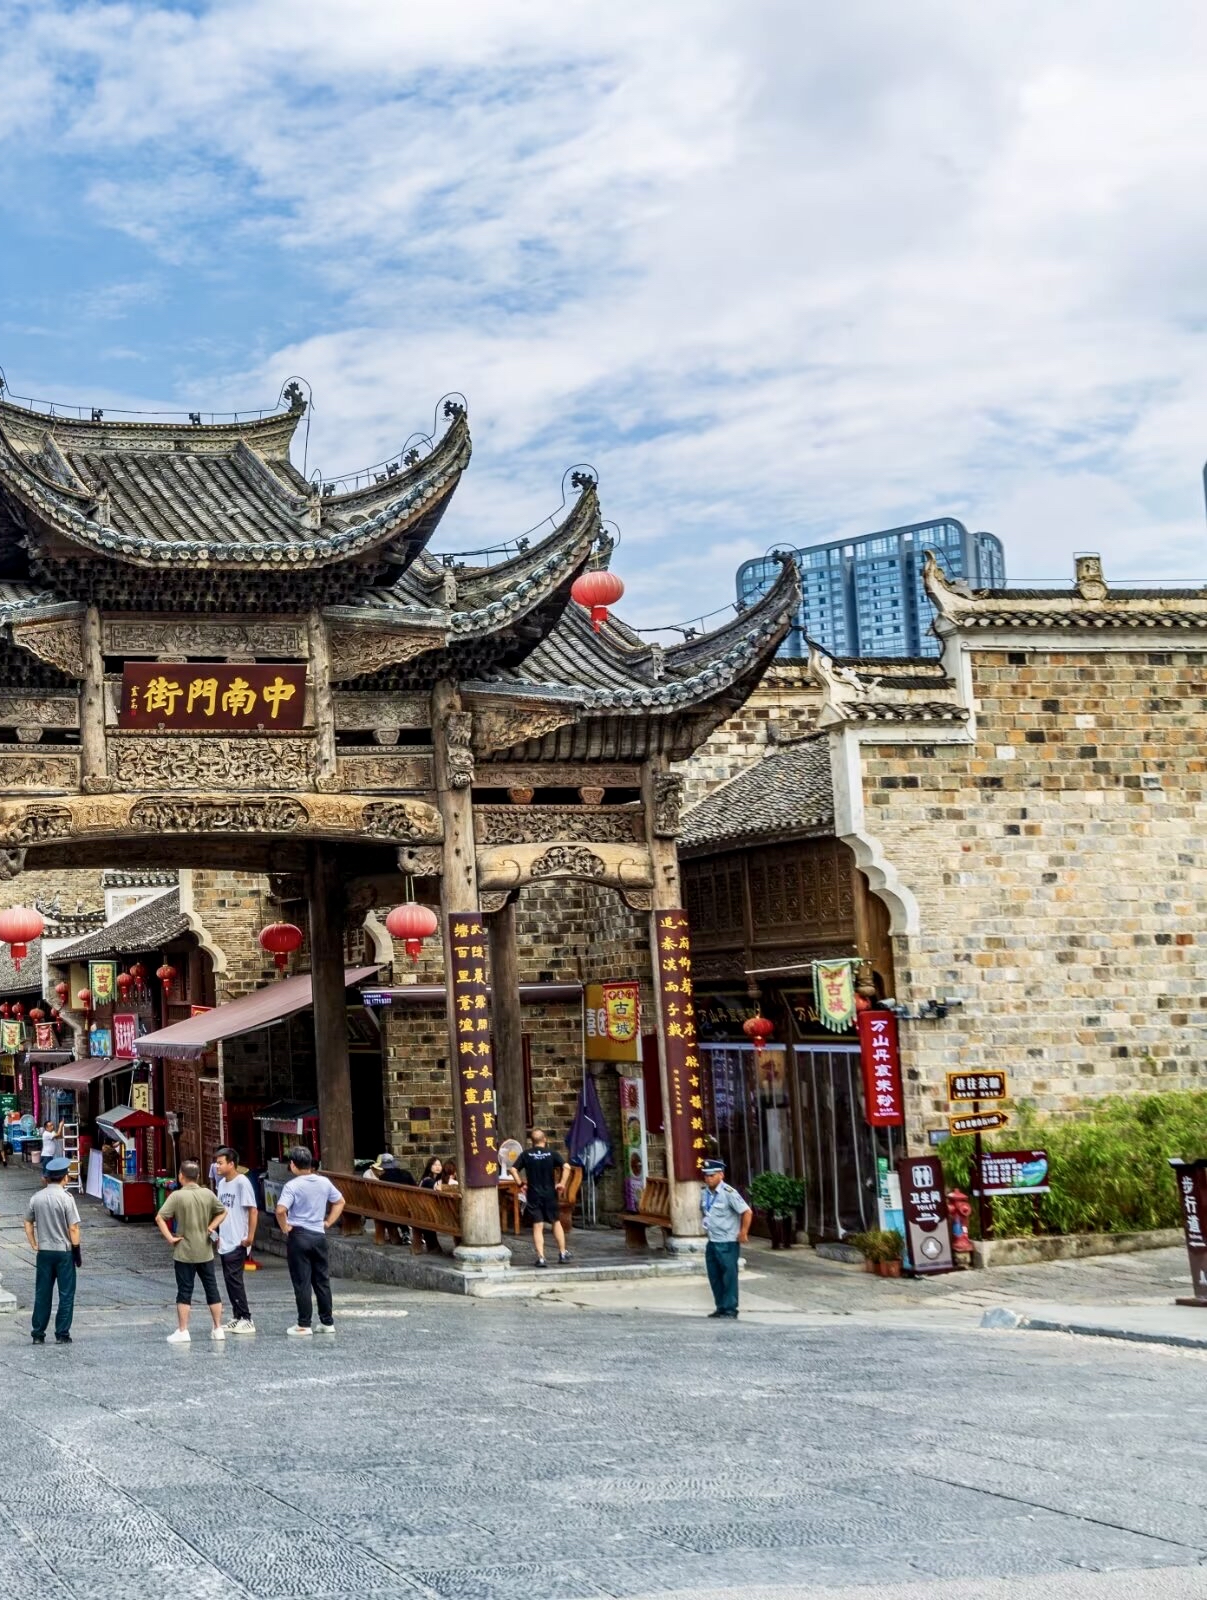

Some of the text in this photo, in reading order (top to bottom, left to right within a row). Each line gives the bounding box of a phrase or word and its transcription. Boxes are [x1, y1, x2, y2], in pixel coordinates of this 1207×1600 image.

[825, 981, 848, 1013] 古城
[614, 1001, 632, 1035] 古城
[909, 1190, 942, 1205] 卫生间
